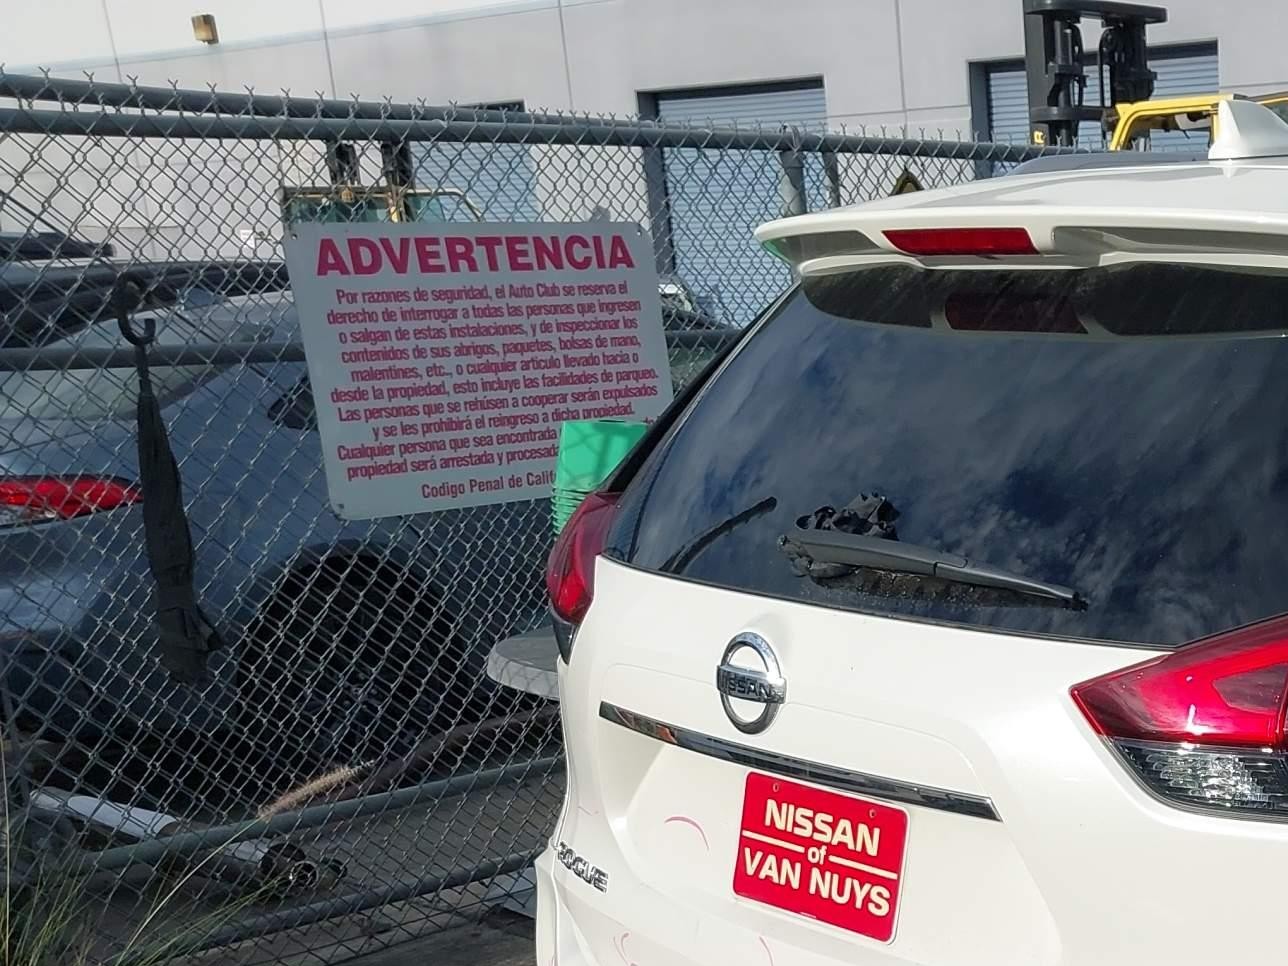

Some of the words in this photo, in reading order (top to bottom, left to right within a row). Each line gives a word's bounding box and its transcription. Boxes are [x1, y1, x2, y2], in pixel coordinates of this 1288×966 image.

[316, 235, 635, 276] ADVERTENCIA
[336, 289, 359, 304] Por
[362, 288, 411, 304] razones
[414, 287, 428, 301] de
[495, 285, 506, 299] el
[508, 284, 534, 298] Auto
[536, 282, 560, 297] Club
[562, 285, 575, 297] se
[577, 283, 616, 296] reserva
[618, 280, 628, 294] el
[327, 308, 378, 325] derecho
[382, 308, 397, 322] de
[400, 306, 458, 324] interrogar
[462, 308, 470, 319] a
[472, 304, 504, 318] todas
[506, 303, 523, 317] las
[526, 303, 574, 319] personas
[577, 301, 596, 316] que
[598, 299, 642, 315] ingresen
[339, 332, 347, 344] o
[350, 328, 392, 345] salgan
[395, 326, 410, 341] de
[414, 325, 447, 340] estas
[449, 322, 528, 338] instalaciones,
[530, 323, 538, 337] y
[540, 319, 553, 334] de
[555, 318, 620, 335] inspeccionar
[623, 316, 638, 330] los
[341, 346, 410, 364] contenidos
[413, 345, 428, 360] de
[430, 347, 451, 358] sus
[454, 342, 500, 359] abrigos,
[502, 339, 556, 357] paquetes,
[558, 336, 593, 350] bolsas
[596, 334, 608, 348] de
[610, 335, 642, 348] mano,
[456, 364, 464, 376] o
[466, 359, 518, 376] cualquier
[563, 353, 600, 368] llevado
[602, 351, 630, 365] hacia
[632, 353, 639, 364] o
[330, 386, 369, 403] desde
[372, 385, 384, 400] la
[387, 381, 450, 402] propiedad,
[453, 379, 478, 394] esto
[481, 375, 520, 393] incluye
[522, 374, 540, 389] las
[542, 370, 598, 388] facilidades
[601, 369, 614, 384] de
[616, 368, 658, 384] parqueo.
[338, 407, 362, 422] Las
[364, 405, 420, 423] personas
[422, 403, 444, 418] que
[447, 401, 462, 414] se
[512, 396, 518, 408] a
[522, 393, 568, 409] cooperar
[570, 387, 599, 402] serán
[602, 384, 658, 401] expulsados
[372, 427, 380, 442] y
[382, 425, 398, 438] se
[400, 422, 418, 436] les
[422, 414, 472, 437] prohibirá
[475, 414, 486, 429] el
[488, 412, 540, 430] reingreso
[542, 412, 549, 423] a
[552, 408, 580, 422] dicha
[337, 442, 395, 460] Cualquier
[398, 440, 446, 458] persona
[449, 437, 470, 452] que
[472, 434, 494, 446] sea
[496, 428, 557, 446] encontrada
[347, 458, 408, 482] propiedad
[410, 455, 437, 472] será
[440, 450, 494, 469] arrestada
[497, 452, 504, 466] y
[422, 481, 465, 498] Codigo
[470, 476, 504, 492] Penal
[508, 474, 523, 489] de
[526, 471, 556, 486] Calif
[764, 798, 881, 857] NISSAN
[558, 840, 608, 893] ROGUE
[807, 845, 828, 865] of
[744, 847, 801, 890] VAN
[809, 867, 891, 917] NUYS
